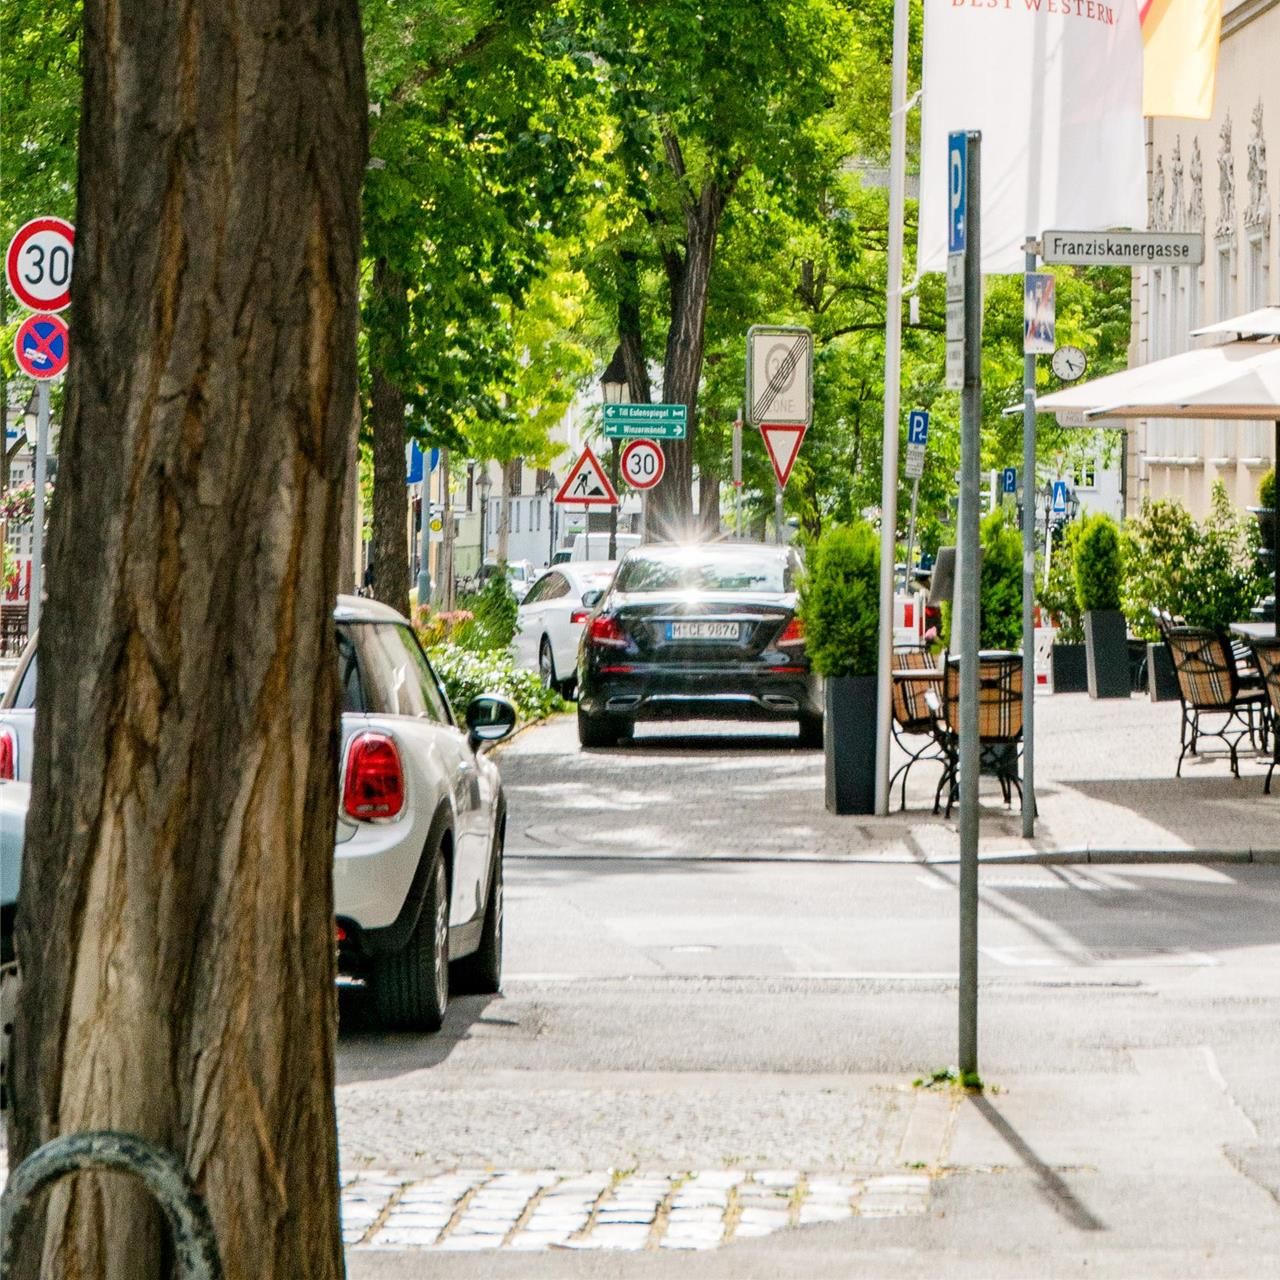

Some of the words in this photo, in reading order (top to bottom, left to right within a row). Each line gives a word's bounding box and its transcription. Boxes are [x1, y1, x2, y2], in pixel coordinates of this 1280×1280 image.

[950, 149, 963, 247] P
[1053, 237, 1190, 260] Franziskanergasse
[24, 244, 70, 287] 30
[619, 407, 629, 417] Till
[912, 415, 925, 441] P
[631, 453, 655, 475] 30
[1006, 471, 1014, 486] P
[673, 623, 681, 636] M
